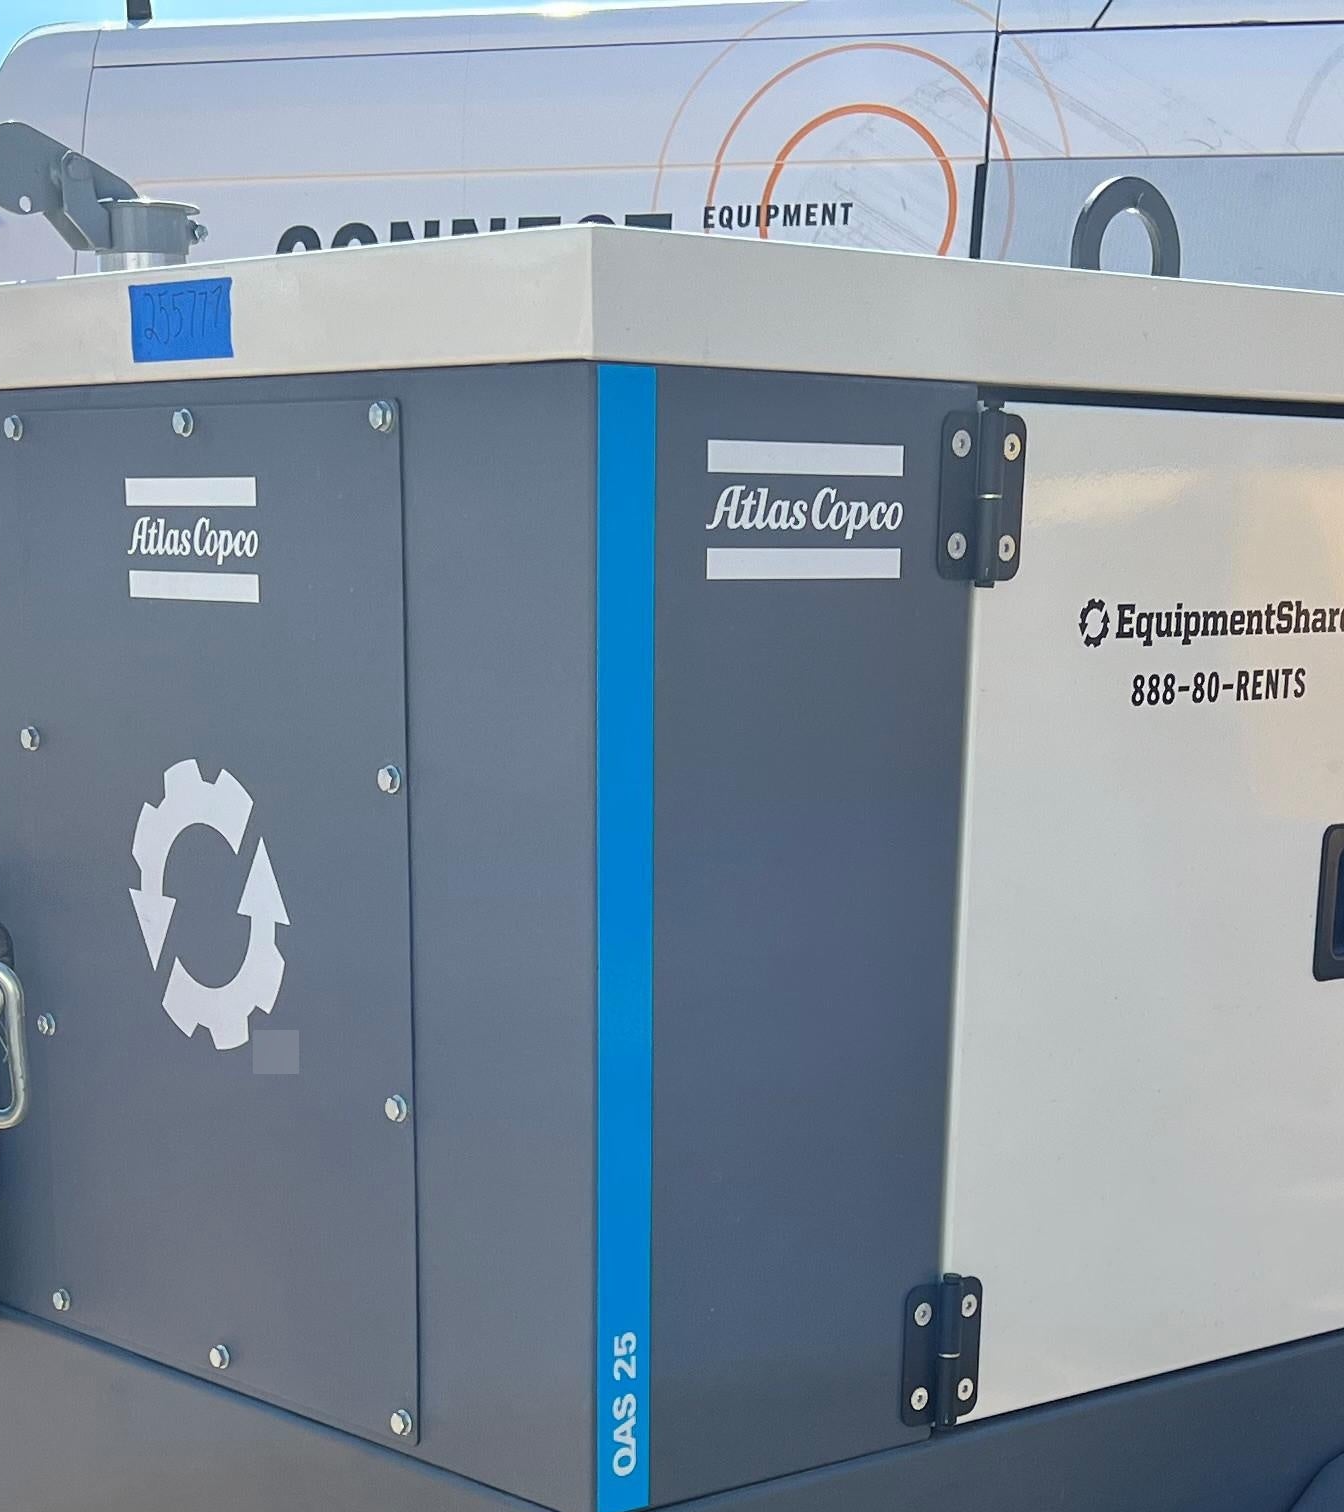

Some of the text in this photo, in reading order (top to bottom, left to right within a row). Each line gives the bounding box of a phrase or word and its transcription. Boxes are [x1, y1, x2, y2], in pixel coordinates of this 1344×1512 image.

[702, 203, 853, 231] EQUIPMENT
[705, 484, 904, 540] Atlas Copco
[127, 516, 259, 566] Atlas Copco
[1131, 667, 1307, 707] 888-80-RENTS
[612, 1331, 637, 1477] QAS 25
